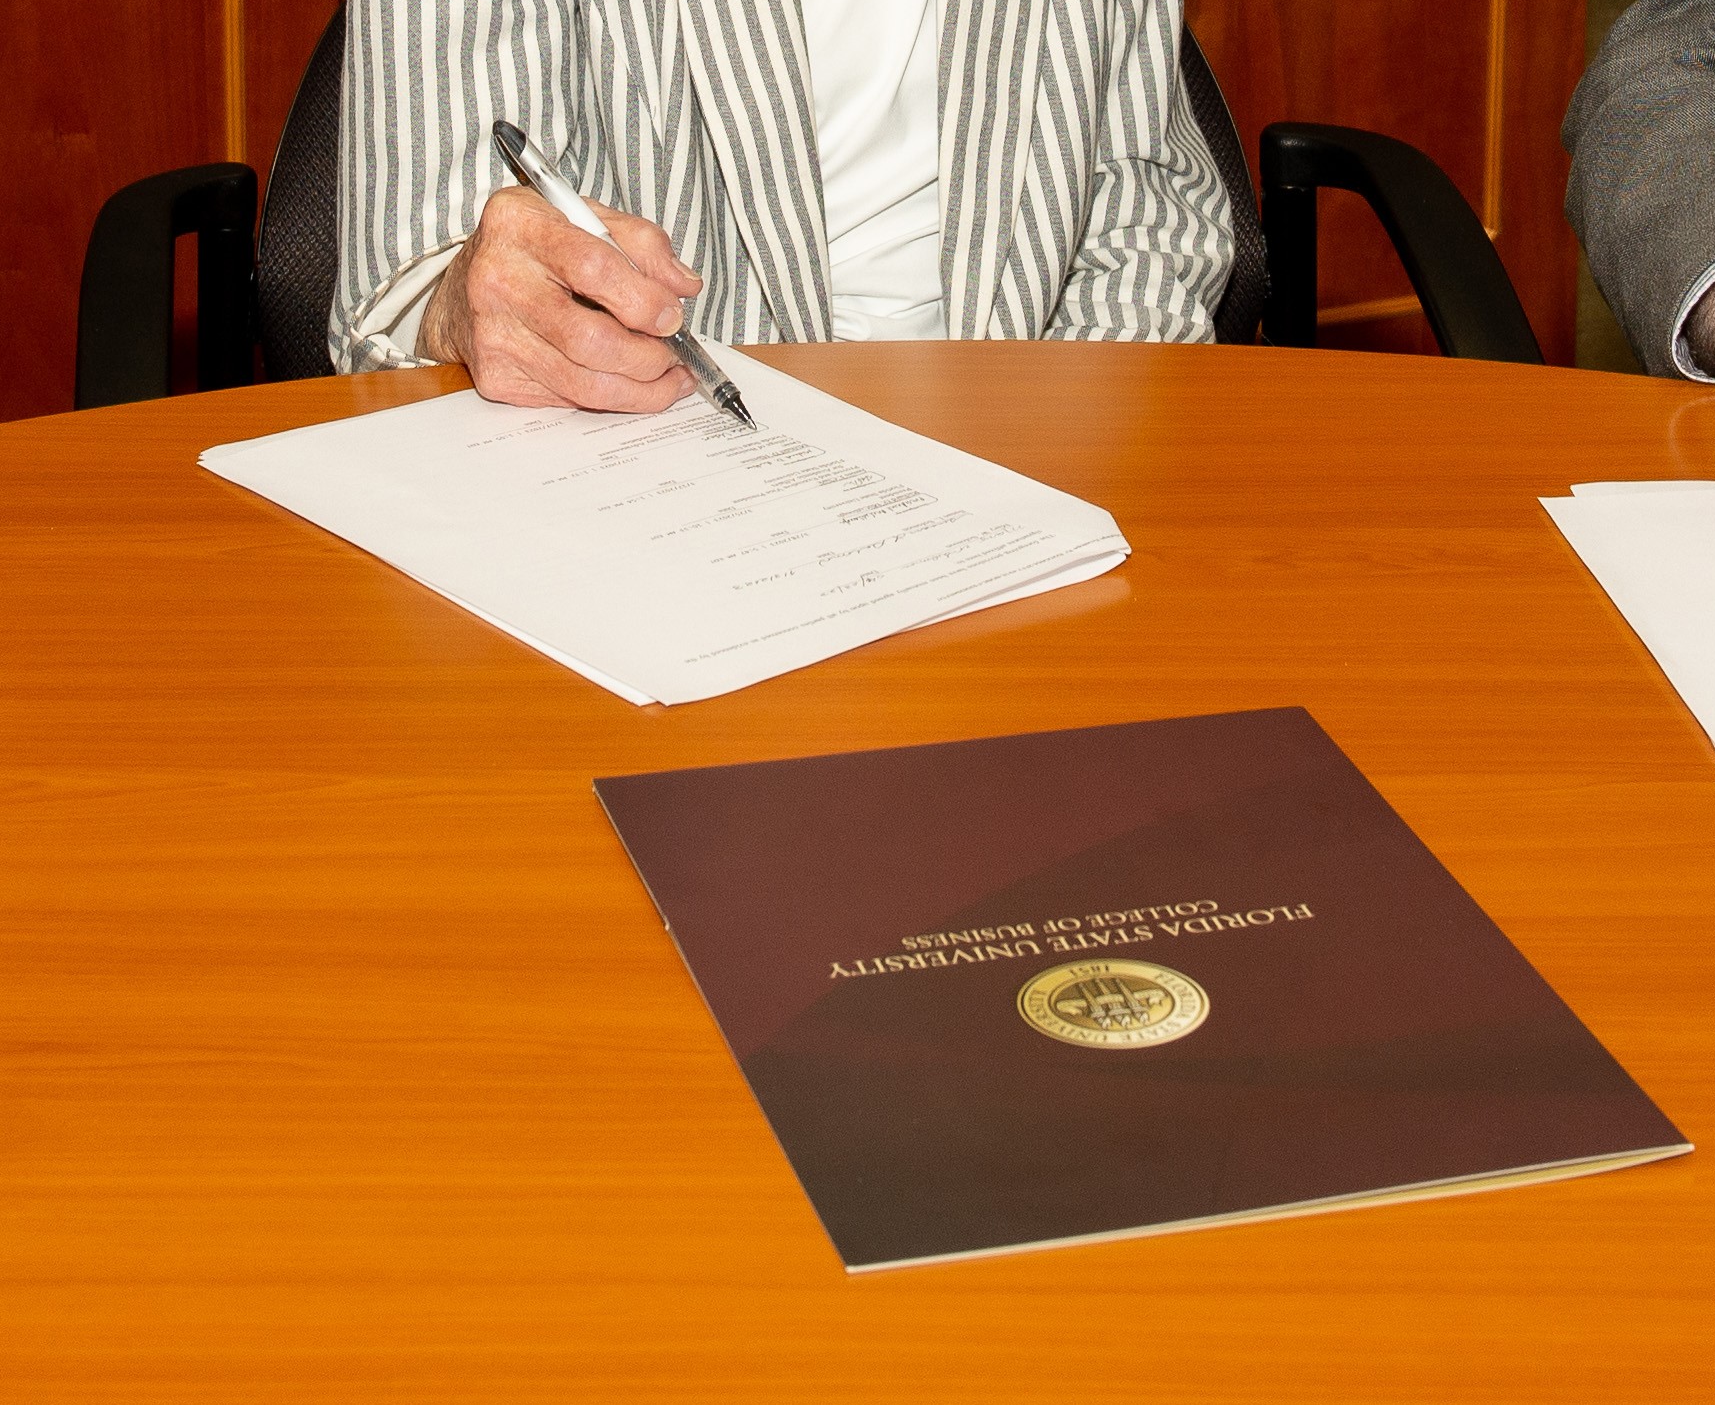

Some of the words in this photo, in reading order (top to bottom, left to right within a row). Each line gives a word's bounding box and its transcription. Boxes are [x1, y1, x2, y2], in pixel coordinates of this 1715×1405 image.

[1043, 917, 1080, 933] OF
[1086, 897, 1219, 928] COLLEGE
[1157, 901, 1315, 936] FLORIDA
[901, 923, 1036, 950] BUSINESS
[1047, 925, 1153, 953] STATE
[830, 939, 1042, 979] UNIVERSITY
[1067, 965, 1110, 978] 1851
[1154, 972, 1196, 1021] FLORIDA
[1028, 990, 1108, 1043] UNIVERSITY
[1118, 1021, 1180, 1043] STATE
